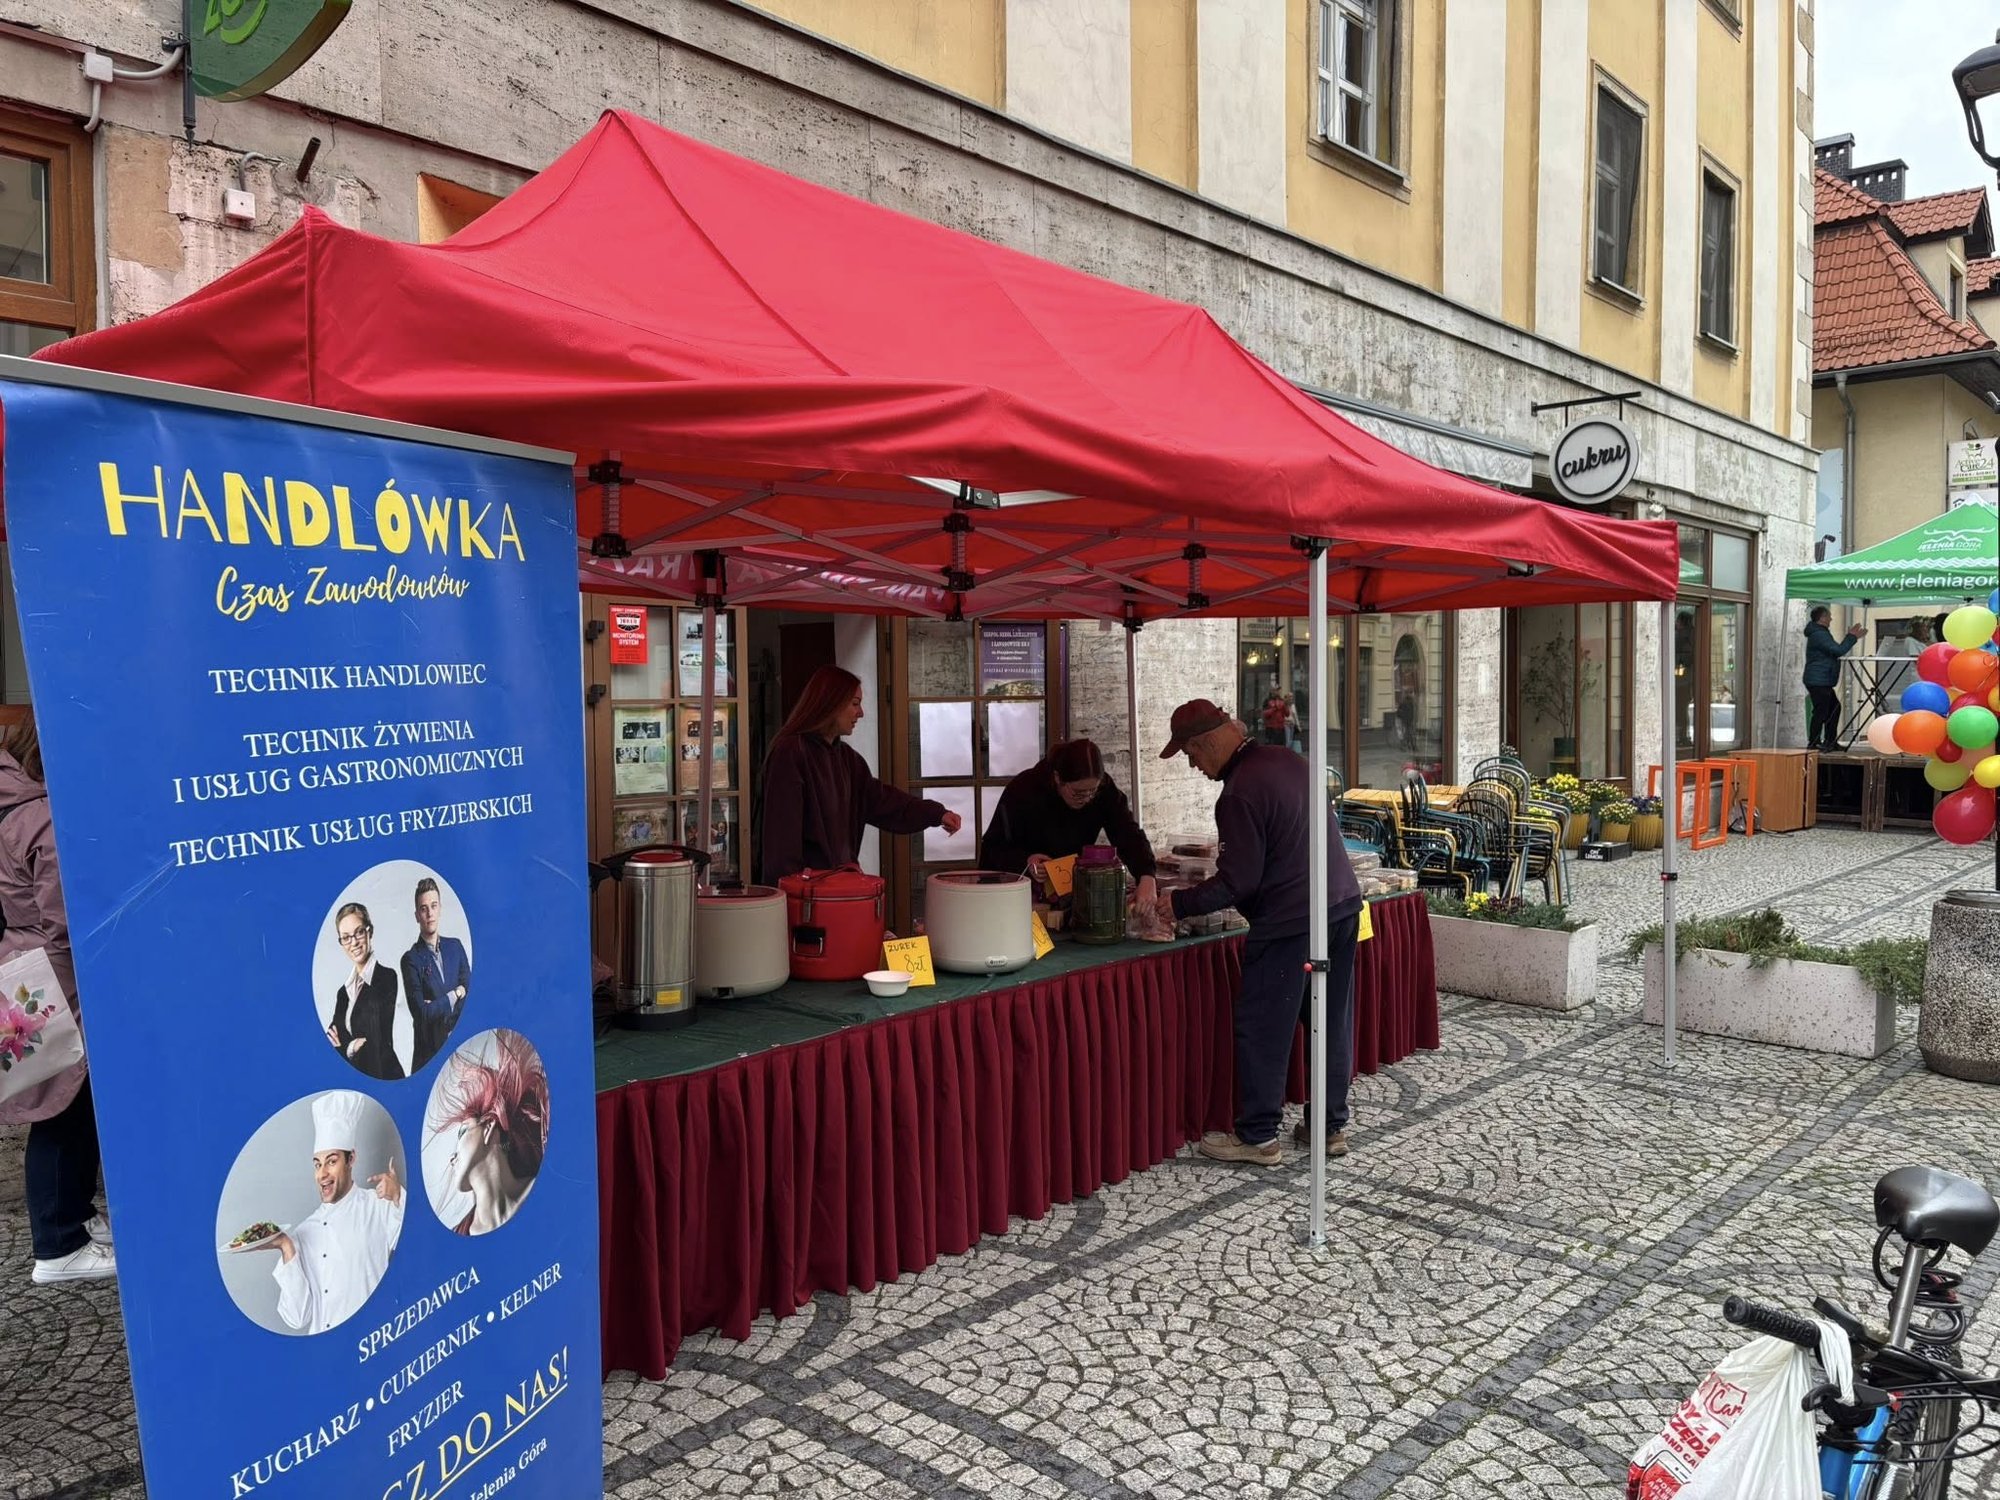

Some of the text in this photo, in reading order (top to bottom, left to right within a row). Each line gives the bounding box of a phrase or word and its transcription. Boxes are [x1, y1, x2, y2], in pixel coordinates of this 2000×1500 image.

[1561, 445, 1627, 478] cukru
[98, 462, 526, 561] HANDLÓWKA
[1917, 541, 1955, 551] JELENIA
[215, 565, 470, 621] Czas Zawodowców
[1844, 572, 1998, 591] www.jeleniagor
[208, 663, 487, 694] TECHNIK HANDLOWIEC
[243, 719, 475, 757] TECHNIK ŻYWIENIA
[172, 746, 524, 803] I USŁUG GASTRONOMICZNYCH
[169, 793, 533, 867] TECHNIK USŁUG FRYZJERSKICH
[358, 1266, 480, 1363] SPRZEDAWCA
[230, 1262, 563, 1499] KUCHARZ CUKIERNIK KELNER
[387, 1380, 465, 1457] FRYZJER
[438, 1410, 492, 1483] DO
[504, 1345, 569, 1431] NAS!
[518, 1437, 548, 1470] Góra
